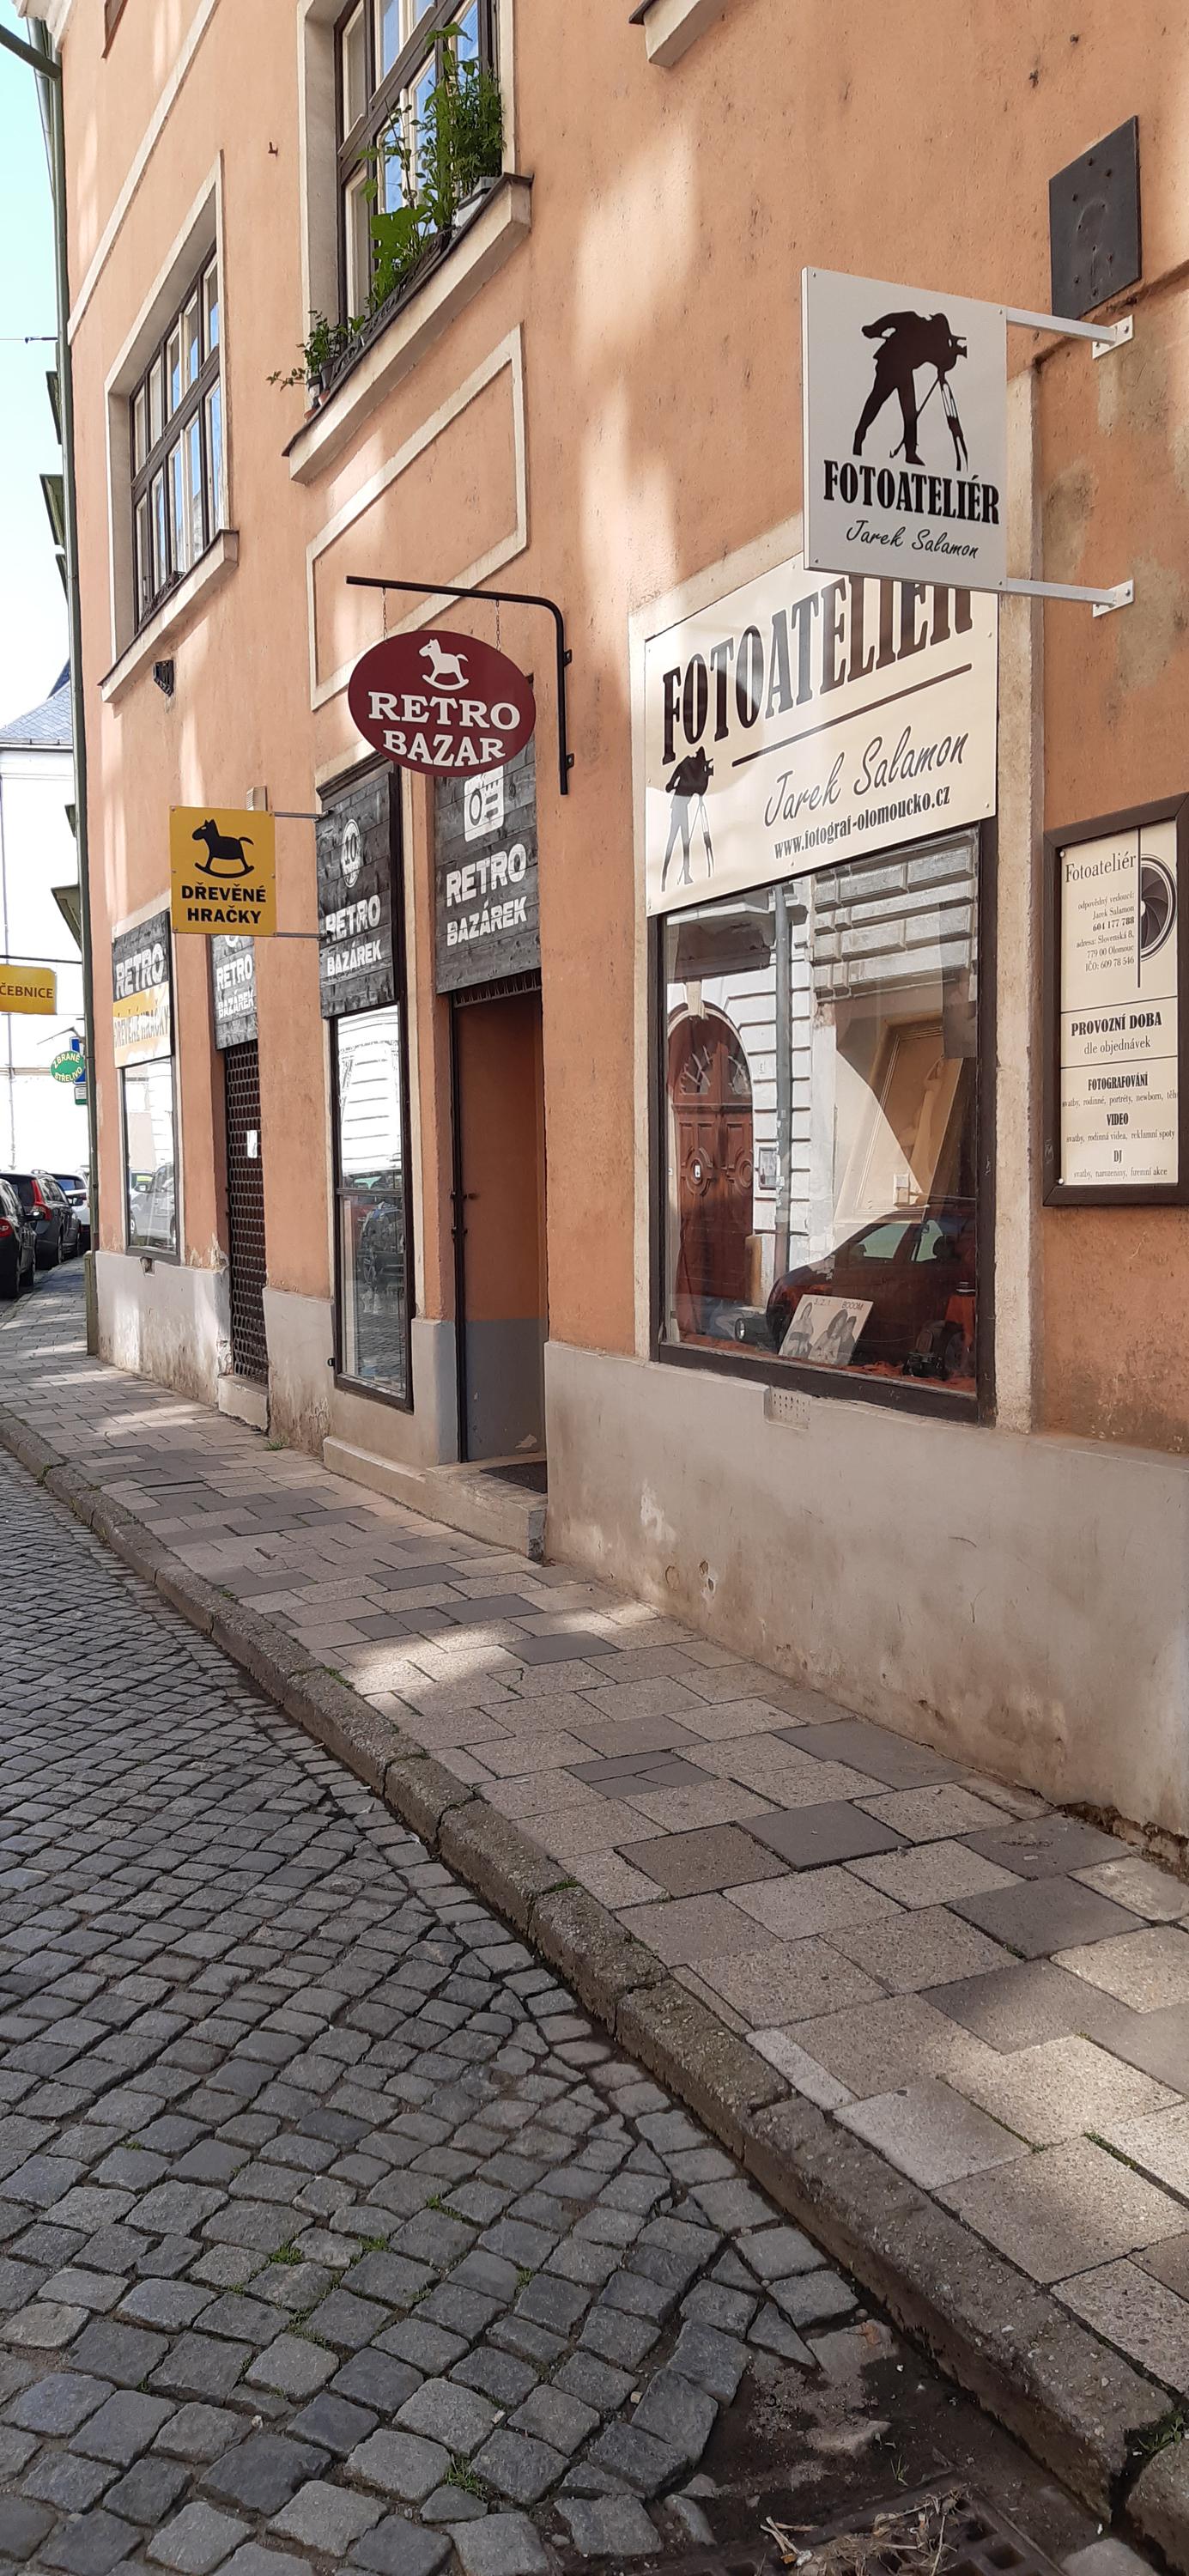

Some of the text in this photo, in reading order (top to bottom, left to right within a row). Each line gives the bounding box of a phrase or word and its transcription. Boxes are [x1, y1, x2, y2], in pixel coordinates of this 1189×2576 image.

[823, 459, 999, 525] FOTOATELIÉR
[846, 519, 979, 559] Jarek Salamon
[367, 691, 521, 731] RETRO
[383, 729, 506, 767] BAZAR
[764, 726, 969, 827] Jarek Salamon
[773, 786, 950, 860] www.fotograf-olomoucko.cz
[446, 843, 527, 908] RETRO
[1065, 851, 1137, 884] Fotoateliér
[181, 882, 266, 902] DŘEVĚNÉ
[187, 904, 261, 924] HRAČKY
[325, 894, 380, 944] RETRO
[446, 896, 527, 946] BAZÁREK
[1092, 905, 1135, 920] Jarek Salamon
[1107, 919, 1120, 929] 177
[1122, 915, 1135, 927] 788
[1097, 931, 1127, 945] Slovenská
[326, 939, 382, 977] BAZÁREK
[1087, 945, 1135, 959] 779 00 Olomouc
[116, 943, 165, 999] RETRO
[216, 954, 253, 992] RETRO
[1085, 960, 1100, 972] IČO:
[1100, 959, 1113, 969] 609
[1113, 957, 1122, 967] 78
[0, 982, 53, 999] ČEBNICE
[217, 989, 254, 1019] BAZÁREK
[1071, 1012, 1162, 1036] PROVOZNÍ DOBA
[1083, 1036, 1151, 1055] dle objednávek
[1088, 1071, 1149, 1091] FOTOGRAFOVÁNÍ
[1136, 1091, 1164, 1102] newborn,
[1106, 1112, 1129, 1126] VIDEO
[1131, 1128, 1157, 1139] reklamní
[1159, 1129, 1175, 1140] spoty
[1113, 1149, 1122, 1163] DJ
[1152, 1166, 1168, 1176] akce
